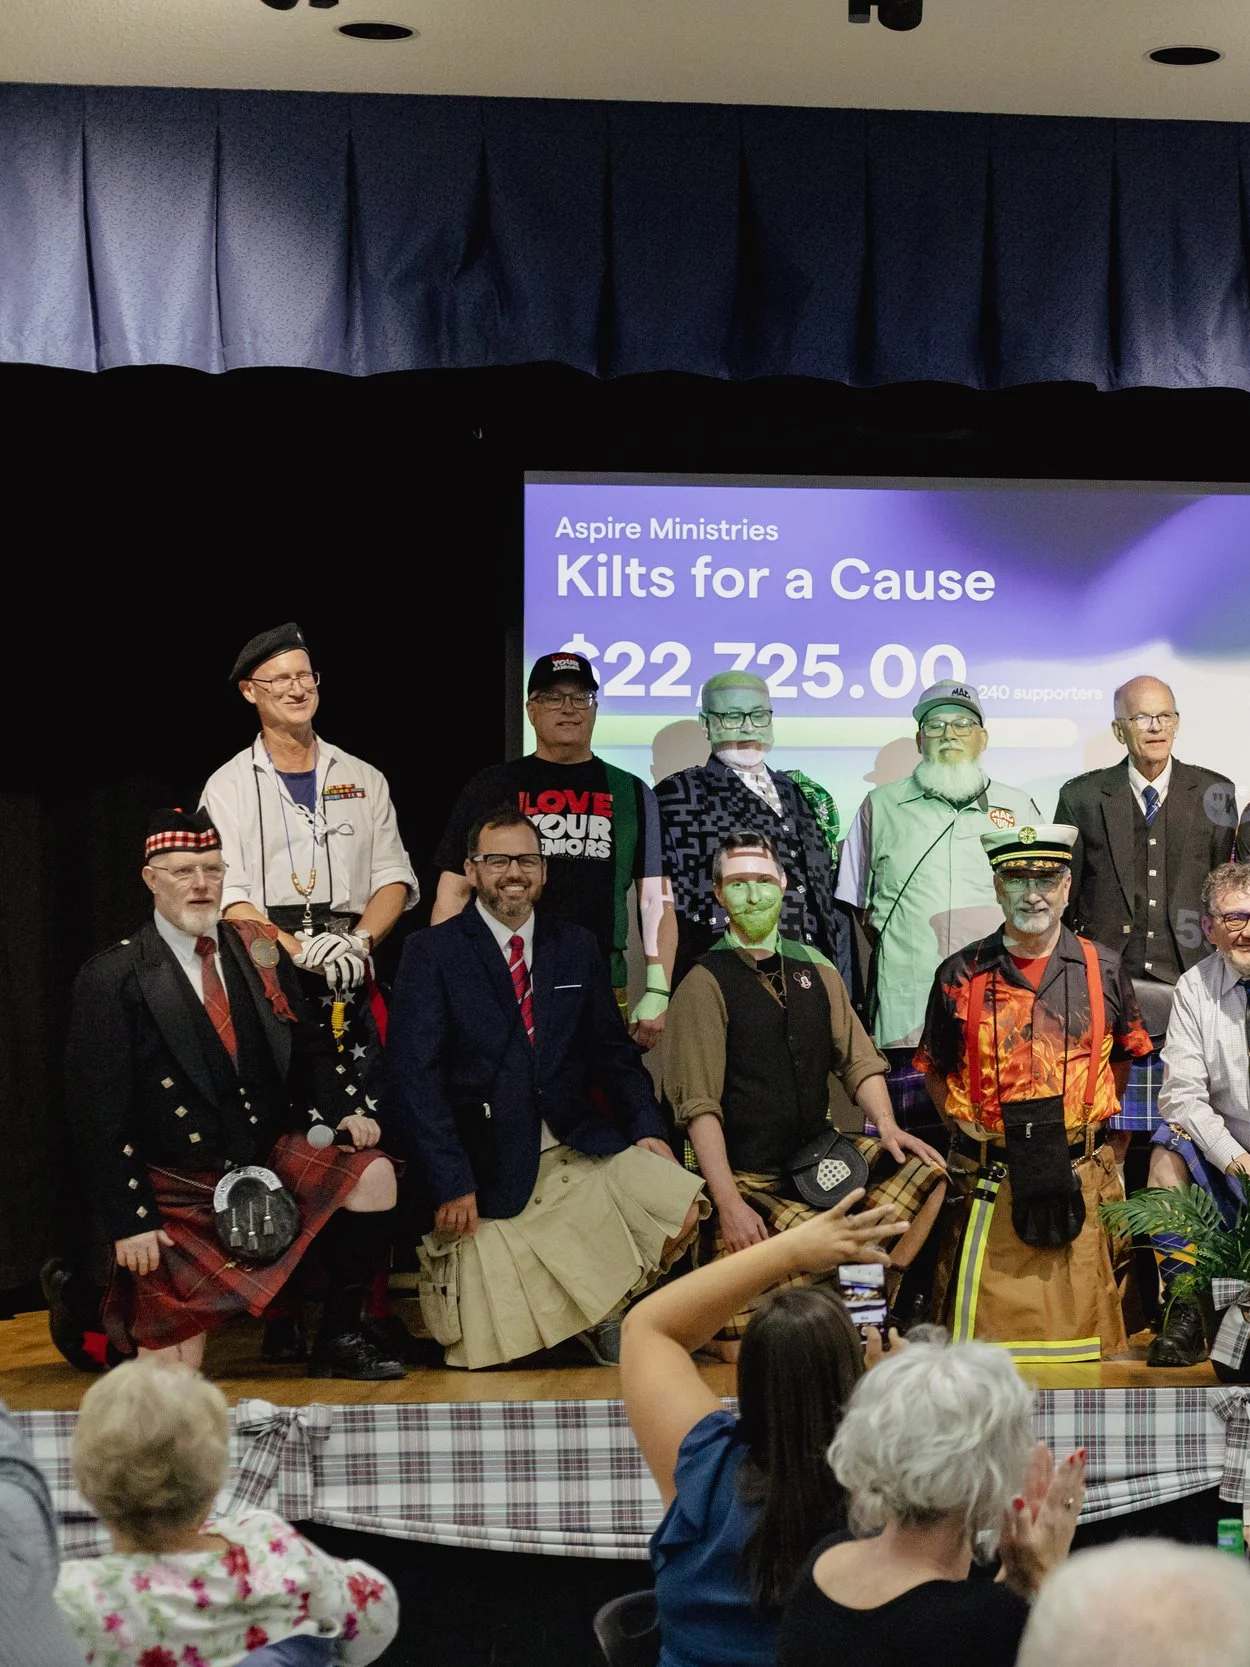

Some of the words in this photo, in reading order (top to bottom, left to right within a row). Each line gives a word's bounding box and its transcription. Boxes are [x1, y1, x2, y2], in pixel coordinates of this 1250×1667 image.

[555, 516, 642, 544] Aspire
[650, 517, 779, 542] Ministries
[557, 553, 675, 599] Kilts
[691, 555, 770, 599] for
[785, 567, 813, 599] a
[831, 557, 996, 602] Cause
[978, 685, 1010, 700] 240
[1014, 686, 1103, 703] supporters
